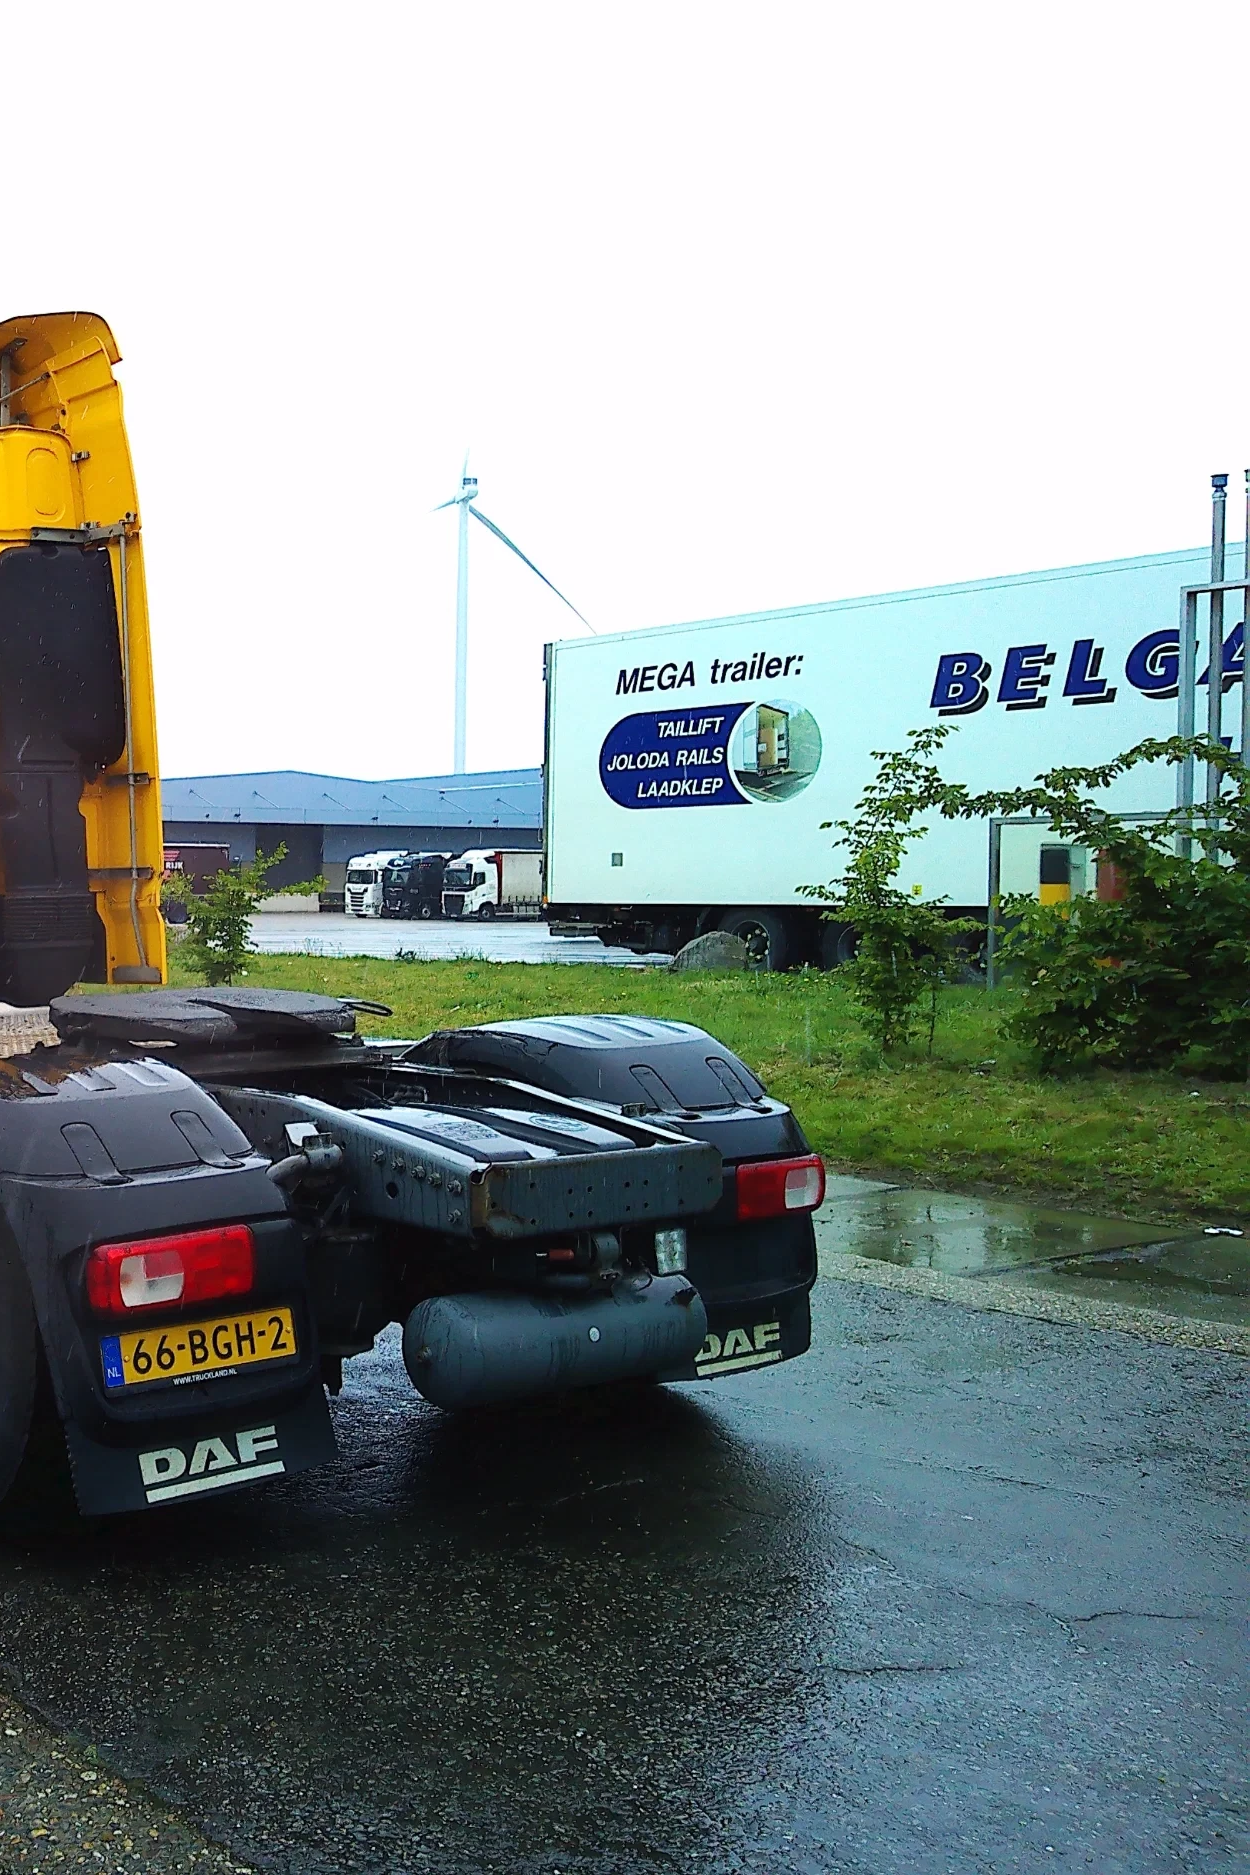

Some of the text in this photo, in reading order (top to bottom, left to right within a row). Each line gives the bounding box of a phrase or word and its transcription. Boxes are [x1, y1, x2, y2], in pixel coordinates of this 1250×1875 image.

[615, 652, 804, 695] MEGA trailer:
[658, 717, 725, 738] TAILLIFT
[607, 747, 724, 771] JOLODA RAILS
[637, 778, 723, 798] LAADKLEP
[132, 1316, 288, 1375] 66-BGH-2
[694, 1322, 781, 1363] DAF
[107, 1366, 122, 1379] NL
[172, 1368, 238, 1386] WWW.TRUCKLAND.NL
[138, 1425, 279, 1486] DAF
